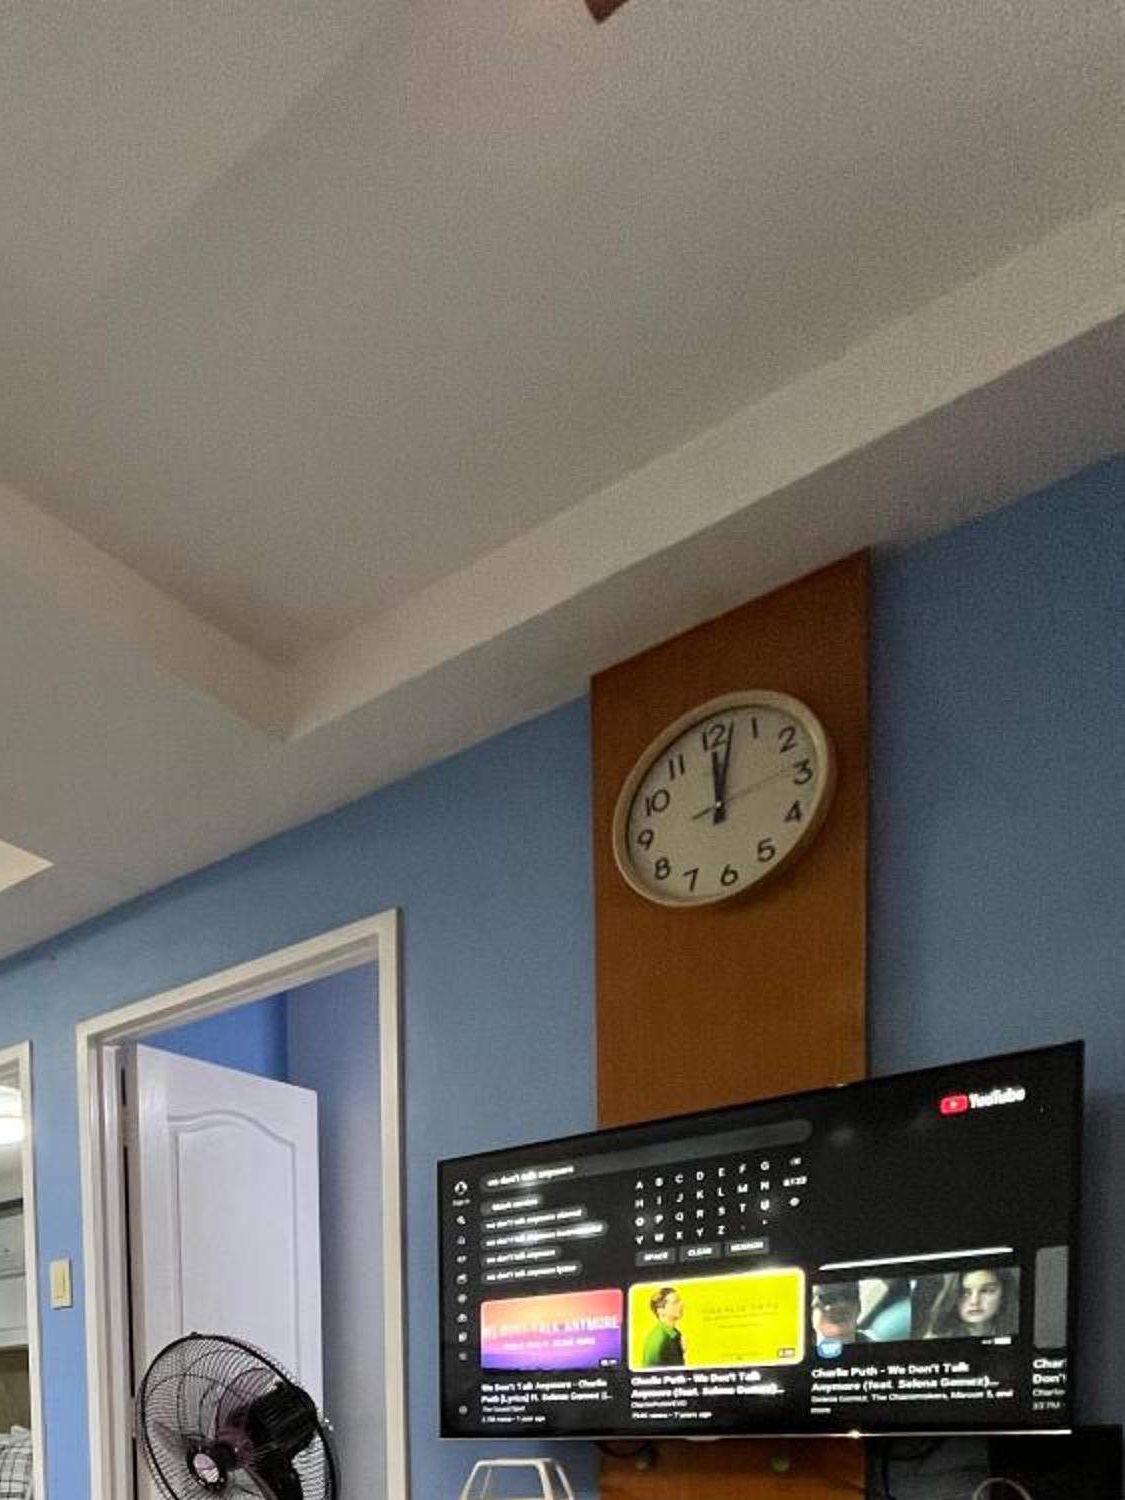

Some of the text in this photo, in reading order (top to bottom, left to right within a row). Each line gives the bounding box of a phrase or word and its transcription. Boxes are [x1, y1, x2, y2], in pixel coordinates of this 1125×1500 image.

[702, 724, 725, 751] 12
[752, 717, 758, 738] 1
[779, 726, 797, 753] 2
[668, 755, 685, 780] 11
[793, 759, 814, 784] 3
[645, 789, 670, 816] 10
[784, 800, 802, 822] 4
[638, 829, 654, 850] 9
[758, 838, 775, 862] 5
[655, 857, 671, 879] 8
[721, 864, 738, 885] 6
[683, 868, 699, 892] 7
[969, 1087, 1026, 1109] YouTube
[635, 1161, 770, 1190] A B C D E F G
[811, 1368, 848, 1378] Charlie
[851, 1366, 878, 1377] Puth
[887, 1364, 906, 1376] We
[908, 1363, 940, 1375] Don't
[942, 1362, 970, 1373] Talk
[811, 1381, 861, 1394] Anymore
[898, 1378, 938, 1389] Selena
